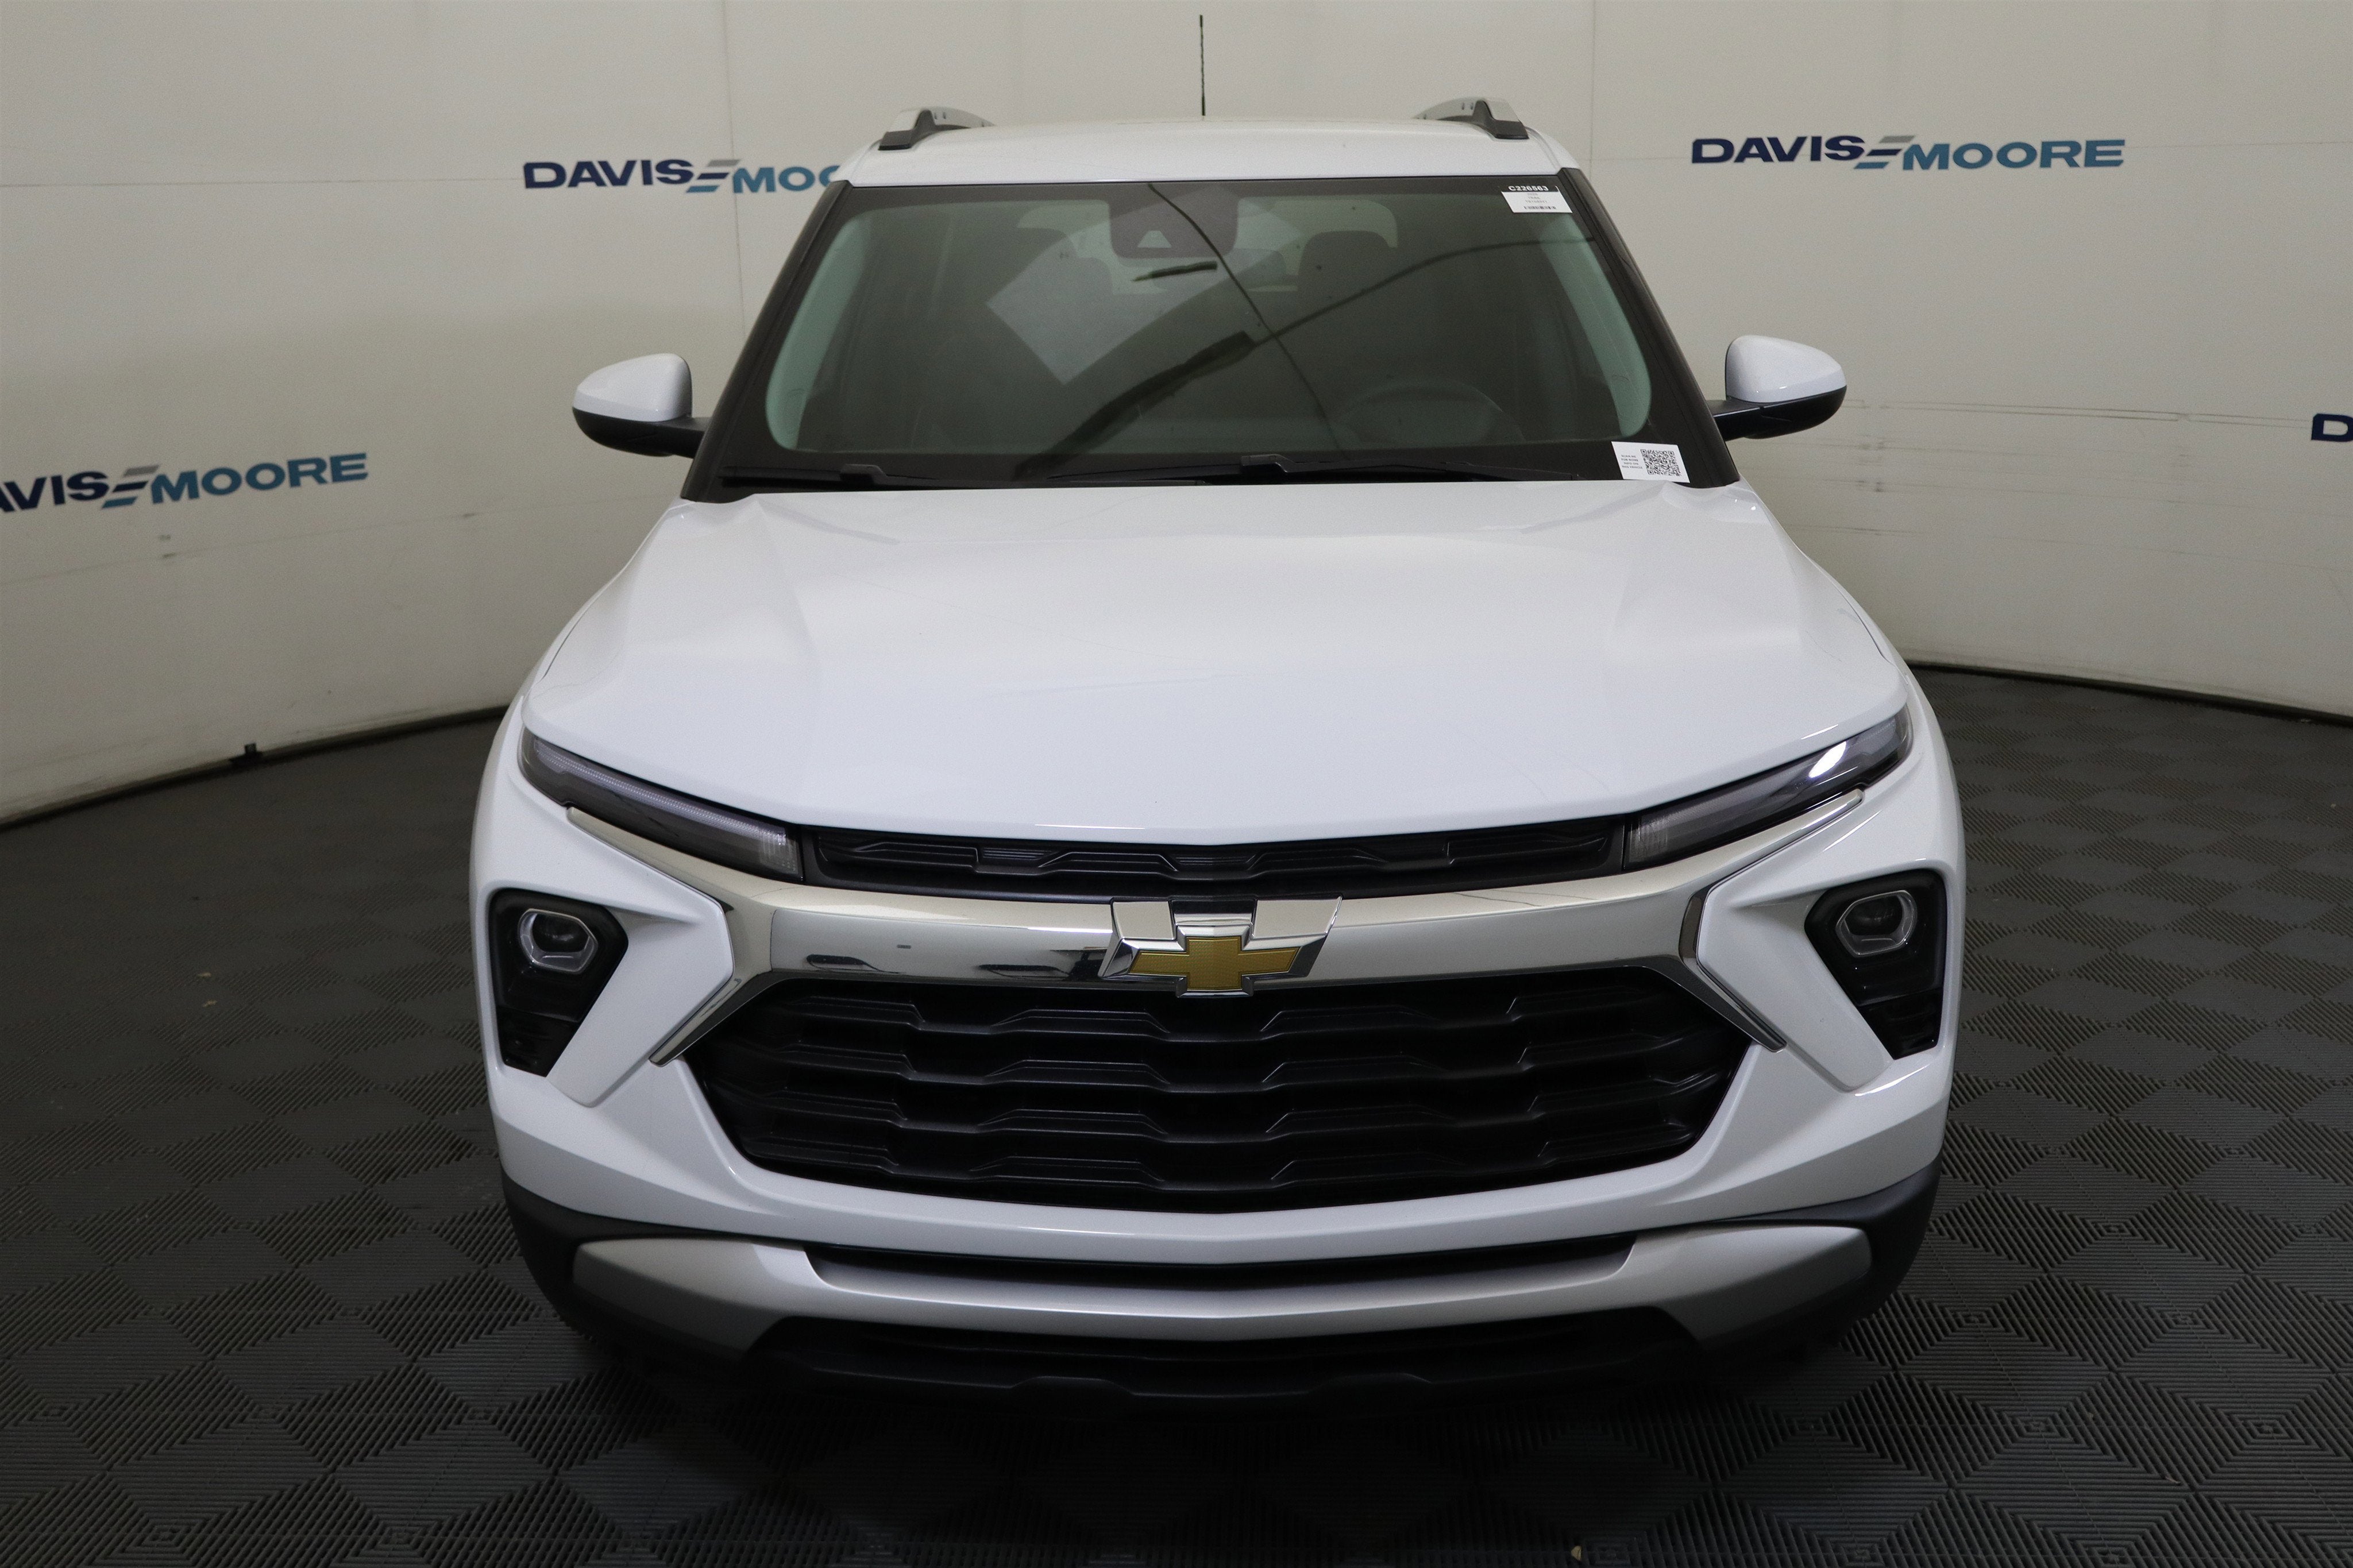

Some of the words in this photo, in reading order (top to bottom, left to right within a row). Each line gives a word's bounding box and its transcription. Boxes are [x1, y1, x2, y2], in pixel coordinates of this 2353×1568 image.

[1691, 134, 1865, 164] DAVIS
[1902, 139, 2126, 171] MOORE
[523, 159, 694, 189] DAVIS
[150, 453, 369, 504] MOORE
